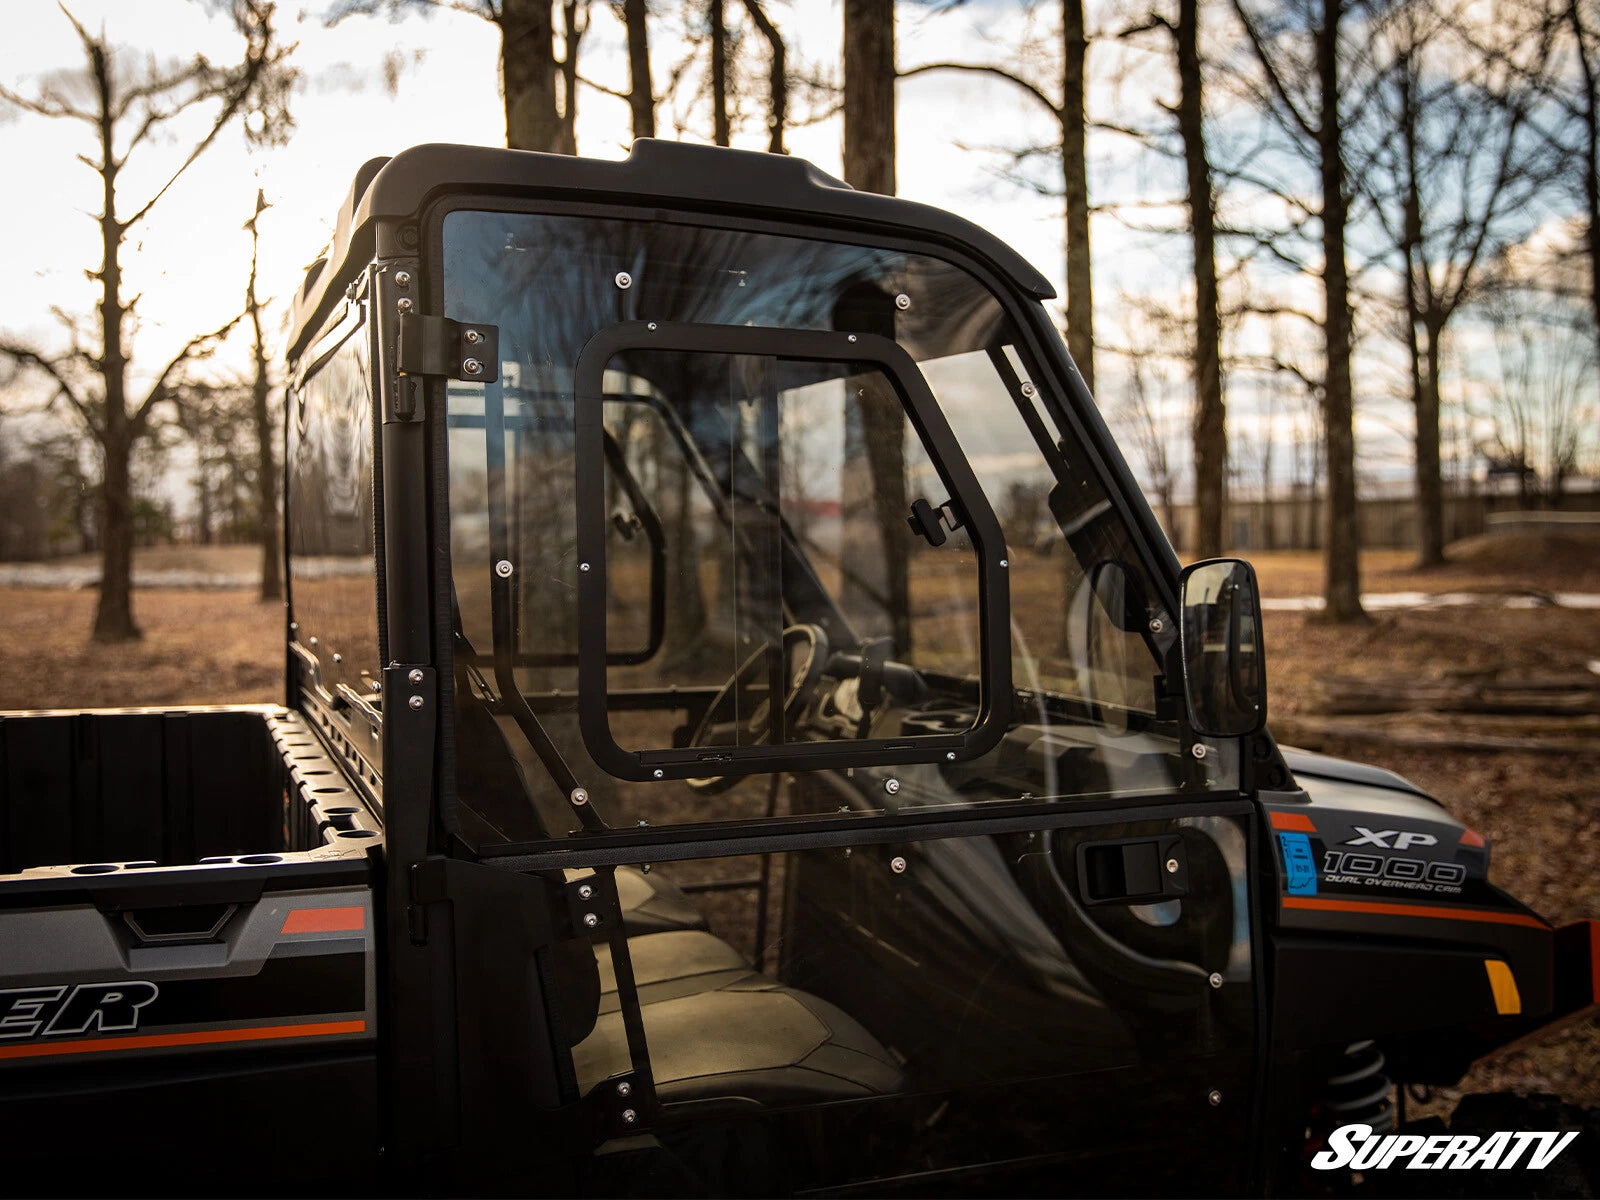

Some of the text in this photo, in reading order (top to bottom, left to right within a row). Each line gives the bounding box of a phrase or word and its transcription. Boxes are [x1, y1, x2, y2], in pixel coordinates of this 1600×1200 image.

[1345, 826, 1438, 849] XP
[1323, 851, 1467, 886] 1000
[1325, 874, 1362, 885] DUAL
[1364, 878, 1435, 891] OVERHEAD
